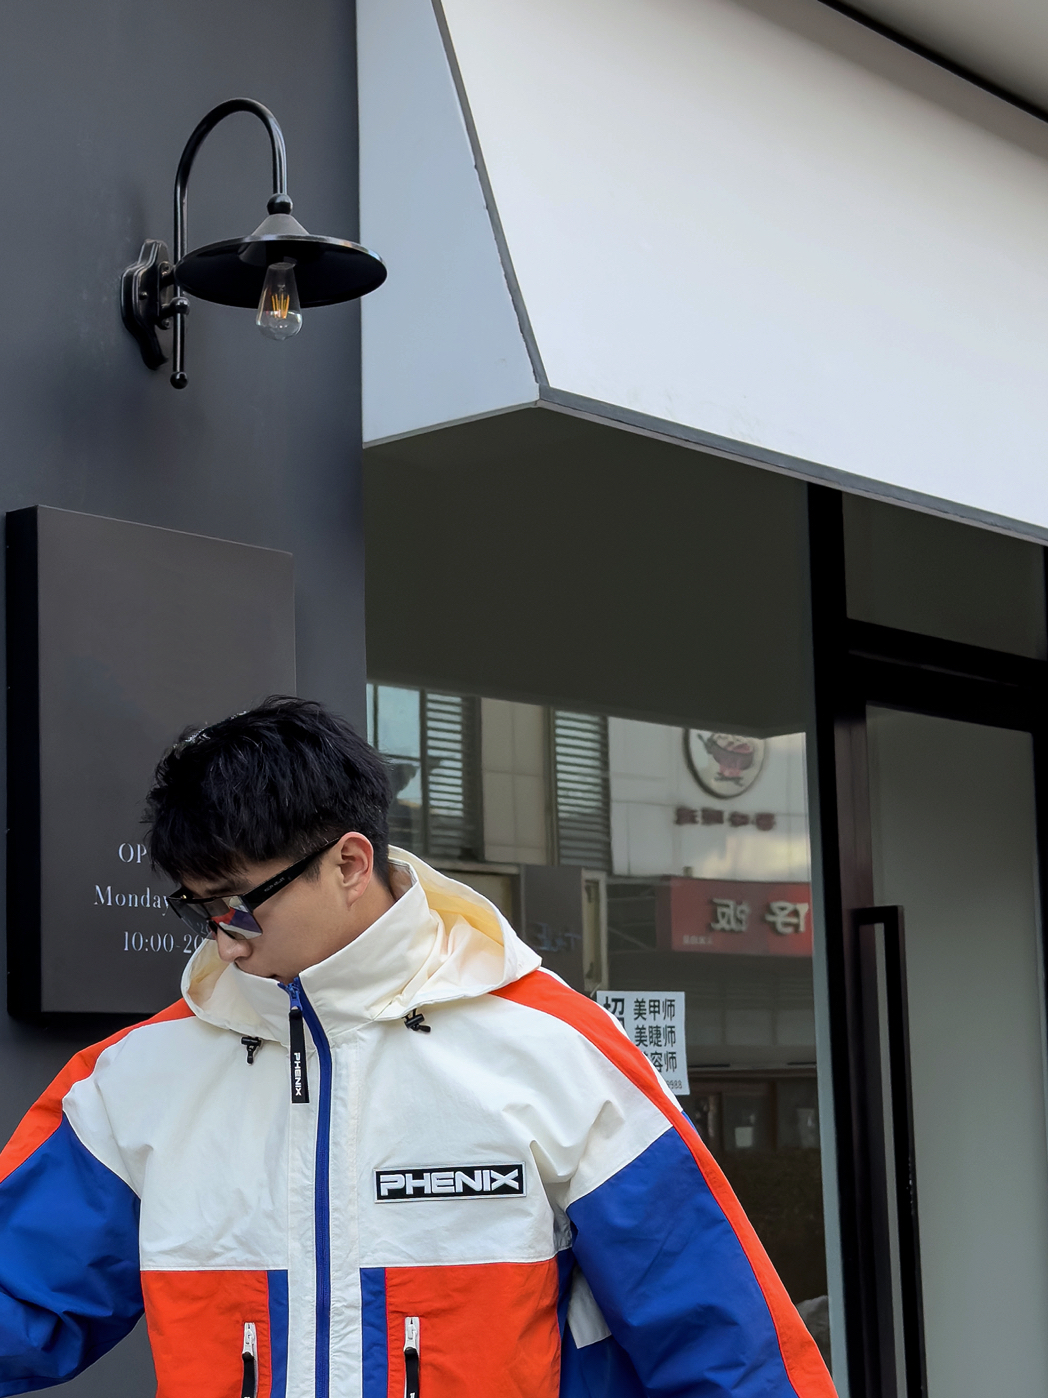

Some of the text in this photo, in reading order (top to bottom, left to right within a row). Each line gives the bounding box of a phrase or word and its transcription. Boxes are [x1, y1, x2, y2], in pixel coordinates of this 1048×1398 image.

[94, 884, 170, 917] Monday
[633, 998, 676, 1021] 美甲师
[634, 1024, 676, 1047] 美睫师
[293, 1052, 303, 1096] PHENIX
[643, 1051, 677, 1073] 容师
[379, 1168, 520, 1197] PHENIX
